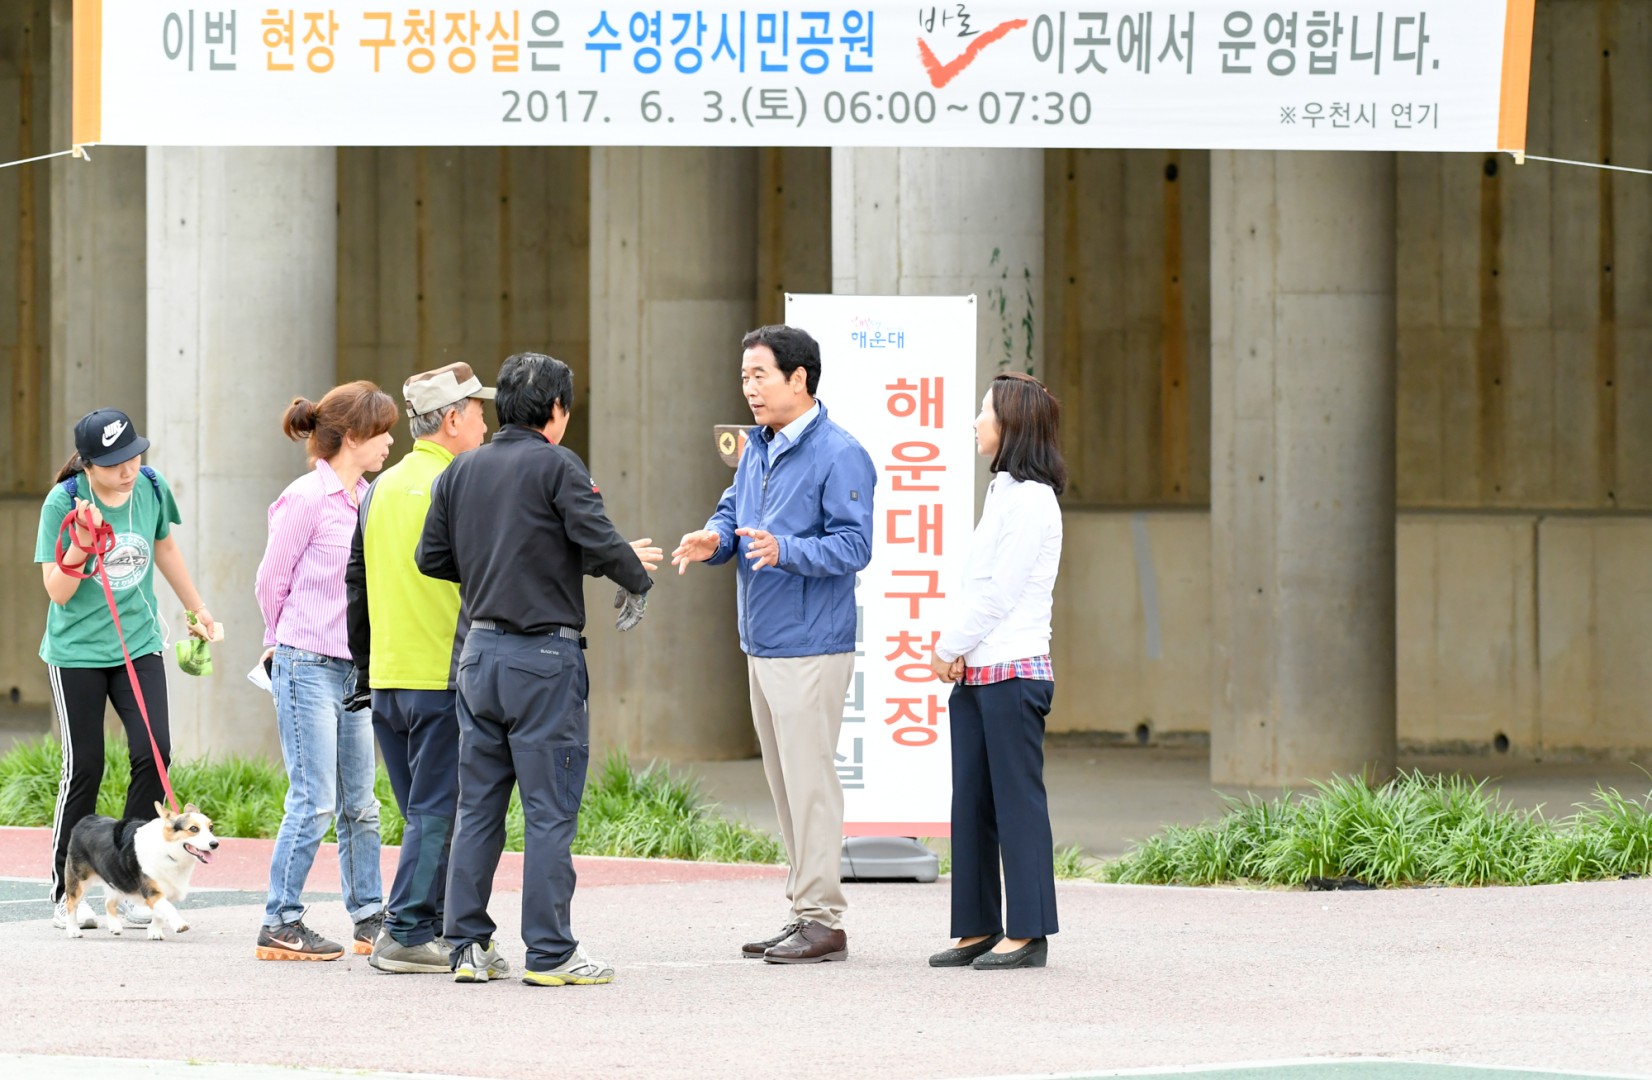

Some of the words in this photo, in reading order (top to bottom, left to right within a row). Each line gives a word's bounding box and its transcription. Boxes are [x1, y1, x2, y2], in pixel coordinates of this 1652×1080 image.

[163, 10, 237, 71] 이번
[261, 9, 339, 74] 현장
[359, 9, 563, 74] 구청장실은
[585, 9, 874, 75] 수영강시민공원
[919, 4, 980, 37] 바로
[1032, 11, 1194, 74] 이곳에서
[1219, 11, 1440, 76] 운영합니다.
[502, 90, 610, 123] 2017.
[641, 90, 674, 123] 6.
[704, 87, 807, 127] 3.(토)
[1392, 102, 1438, 129] 연기
[851, 331, 904, 349] 해운대
[103, 419, 122, 439] NIKE
[884, 376, 947, 747] 해운대구청장
